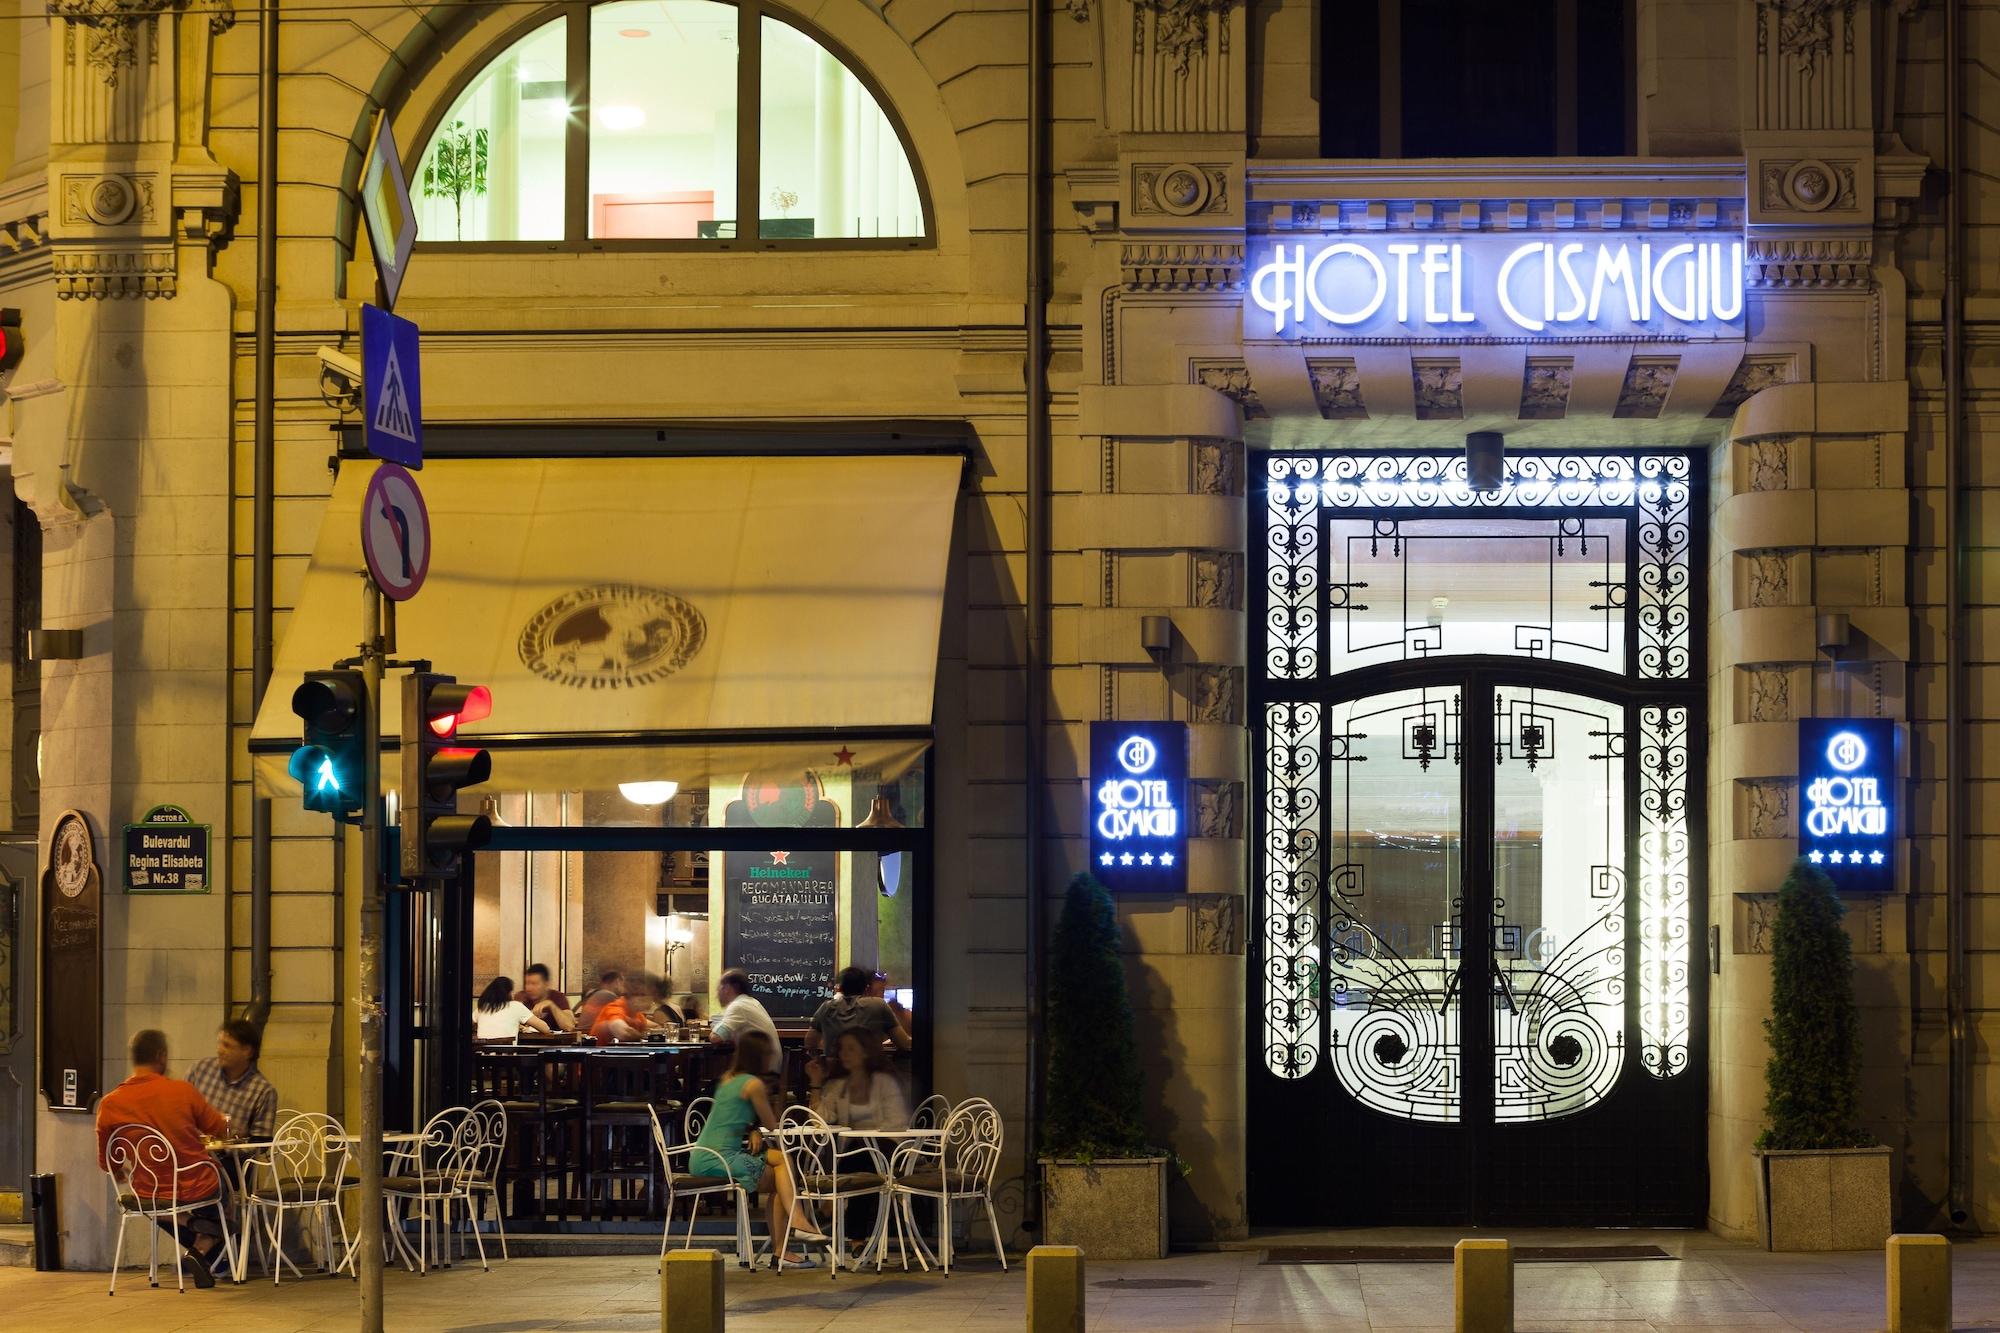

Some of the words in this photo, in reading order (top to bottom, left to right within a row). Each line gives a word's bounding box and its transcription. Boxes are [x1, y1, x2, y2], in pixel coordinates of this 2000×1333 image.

[1250, 243, 1474, 333] HOTEL
[1498, 242, 1742, 331] CISMIGIU
[1098, 779, 1171, 811] HOTEL
[1807, 777, 1881, 808] HOTEL
[142, 834, 191, 849] Bulevardul
[129, 854, 160, 870] Regina
[162, 854, 203, 868] Elisabeta
[153, 873, 179, 884] Nr.38
[748, 866, 810, 879] Heineken
[748, 973, 804, 984] STRONGBOW
